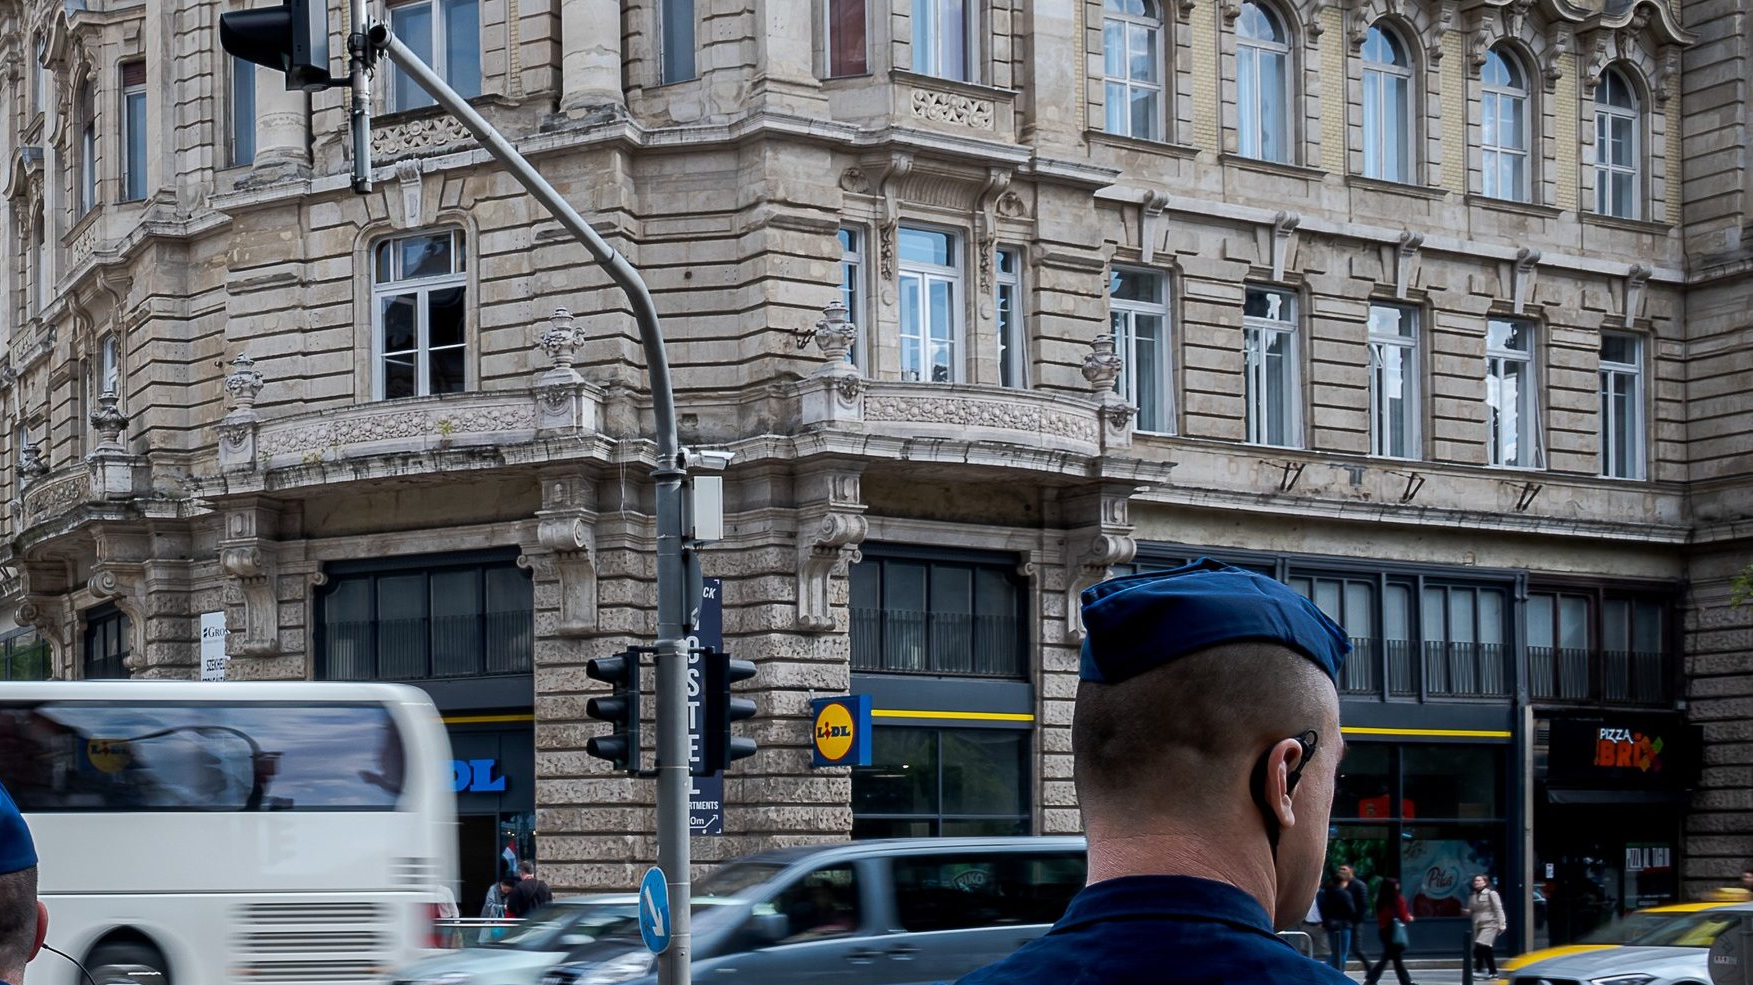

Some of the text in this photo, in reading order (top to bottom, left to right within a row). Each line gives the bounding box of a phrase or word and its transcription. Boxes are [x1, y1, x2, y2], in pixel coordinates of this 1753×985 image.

[702, 586, 716, 599] CK
[1599, 728, 1634, 744] PIZZA
[452, 758, 506, 792] DL
[689, 801, 719, 810] RTMENTS
[690, 816, 705, 825] 0m
